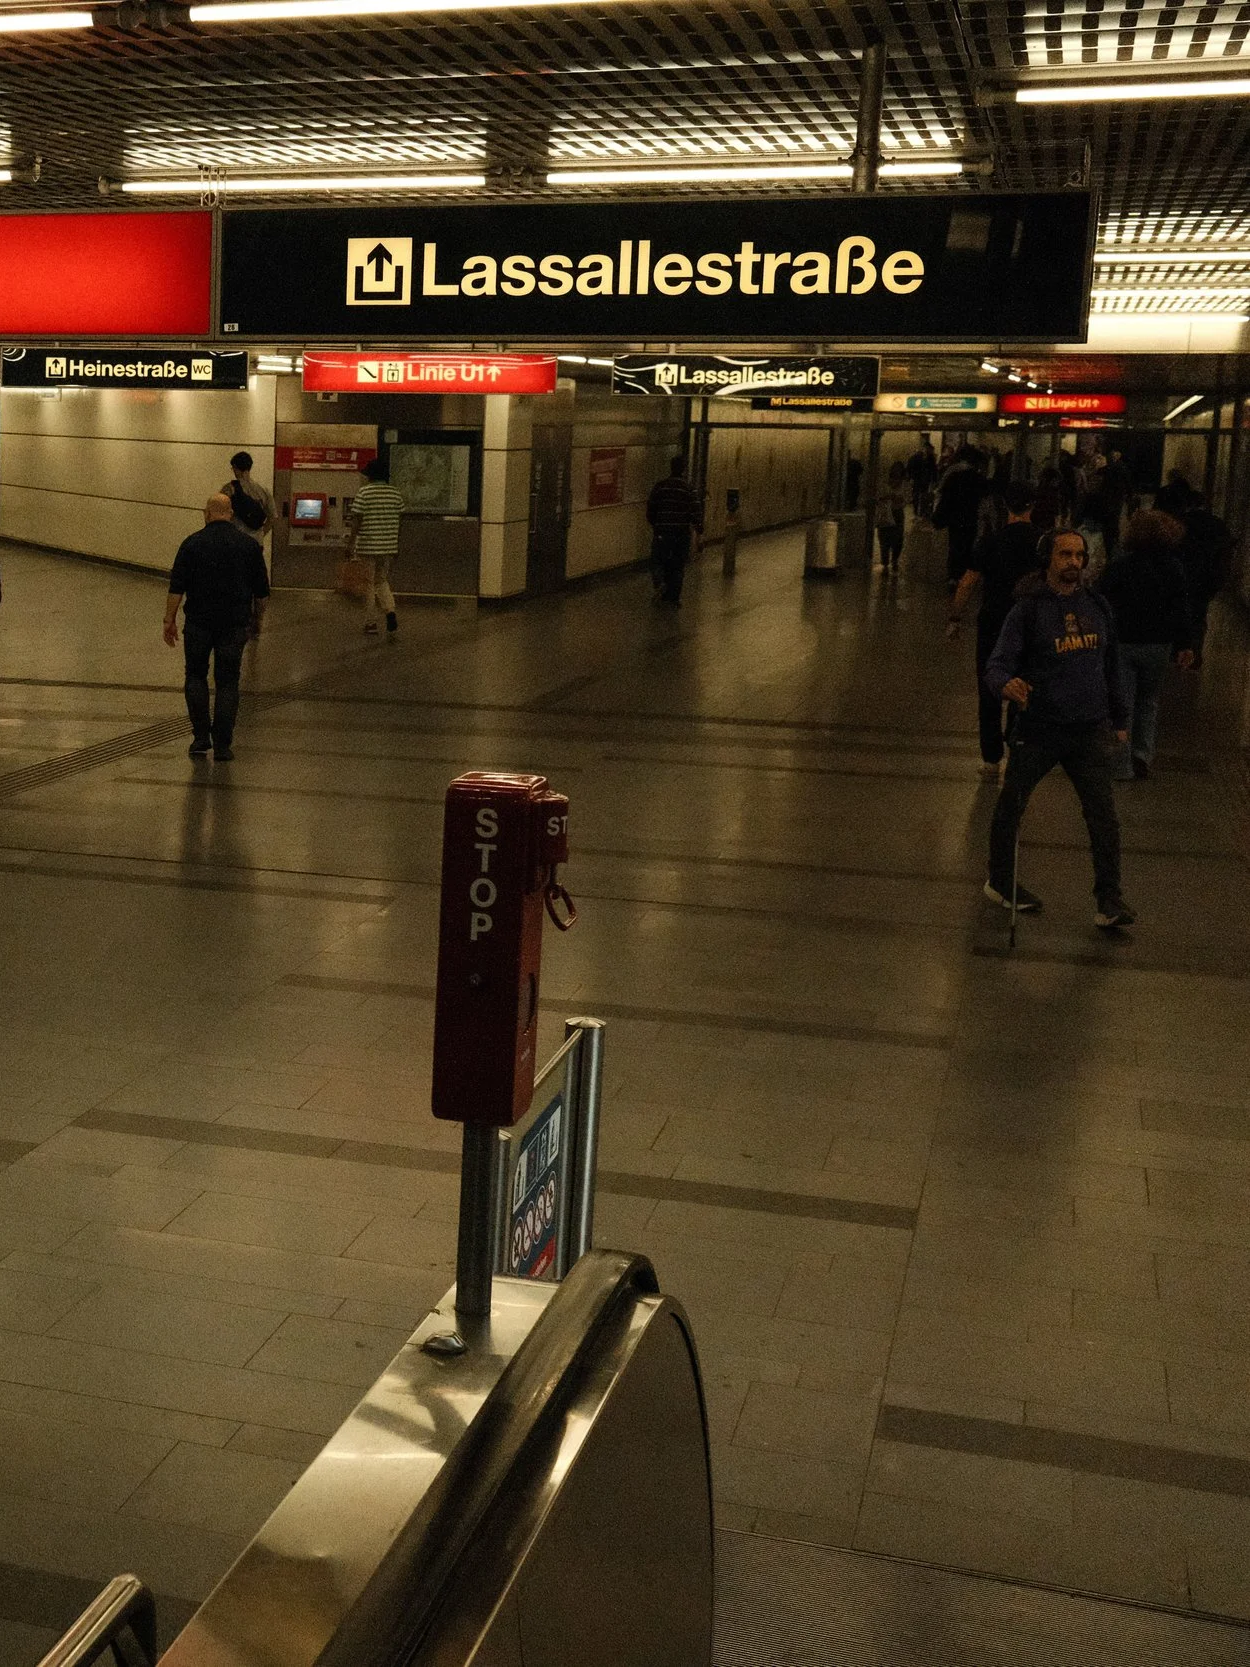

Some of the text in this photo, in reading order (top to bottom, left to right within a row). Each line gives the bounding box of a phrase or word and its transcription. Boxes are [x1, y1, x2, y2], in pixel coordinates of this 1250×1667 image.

[423, 235, 924, 297] Lassallestraße
[69, 359, 211, 378] Heinestraße WC
[406, 363, 484, 381] Linie U1
[680, 365, 835, 386] Lassallestraße
[469, 807, 499, 941] STOP
